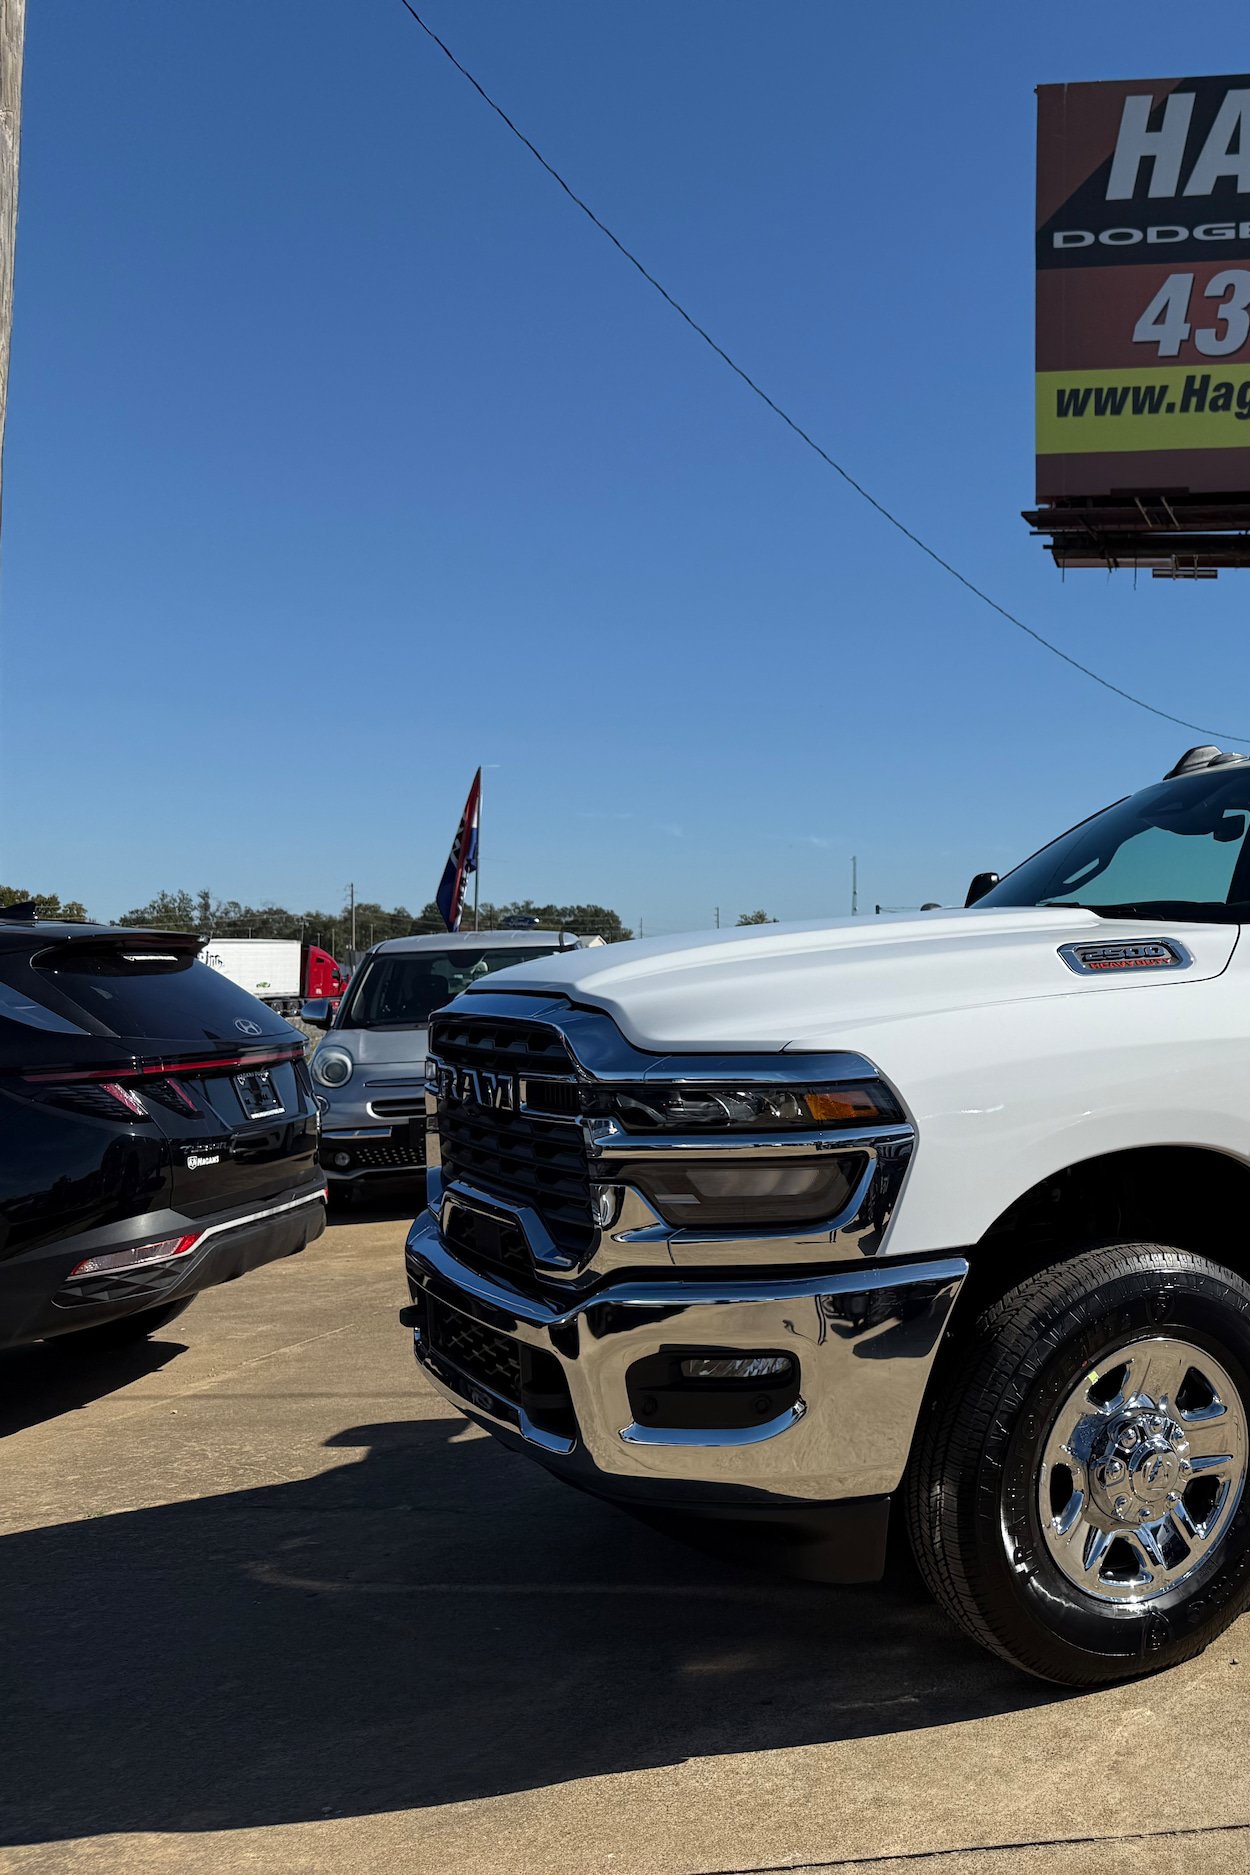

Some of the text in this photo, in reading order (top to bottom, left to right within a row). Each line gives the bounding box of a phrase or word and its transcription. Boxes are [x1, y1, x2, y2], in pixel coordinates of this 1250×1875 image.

[1081, 945, 1166, 962] 2500
[1089, 957, 1171, 969] HEAVY DUTY
[437, 1063, 514, 1111] RAM
